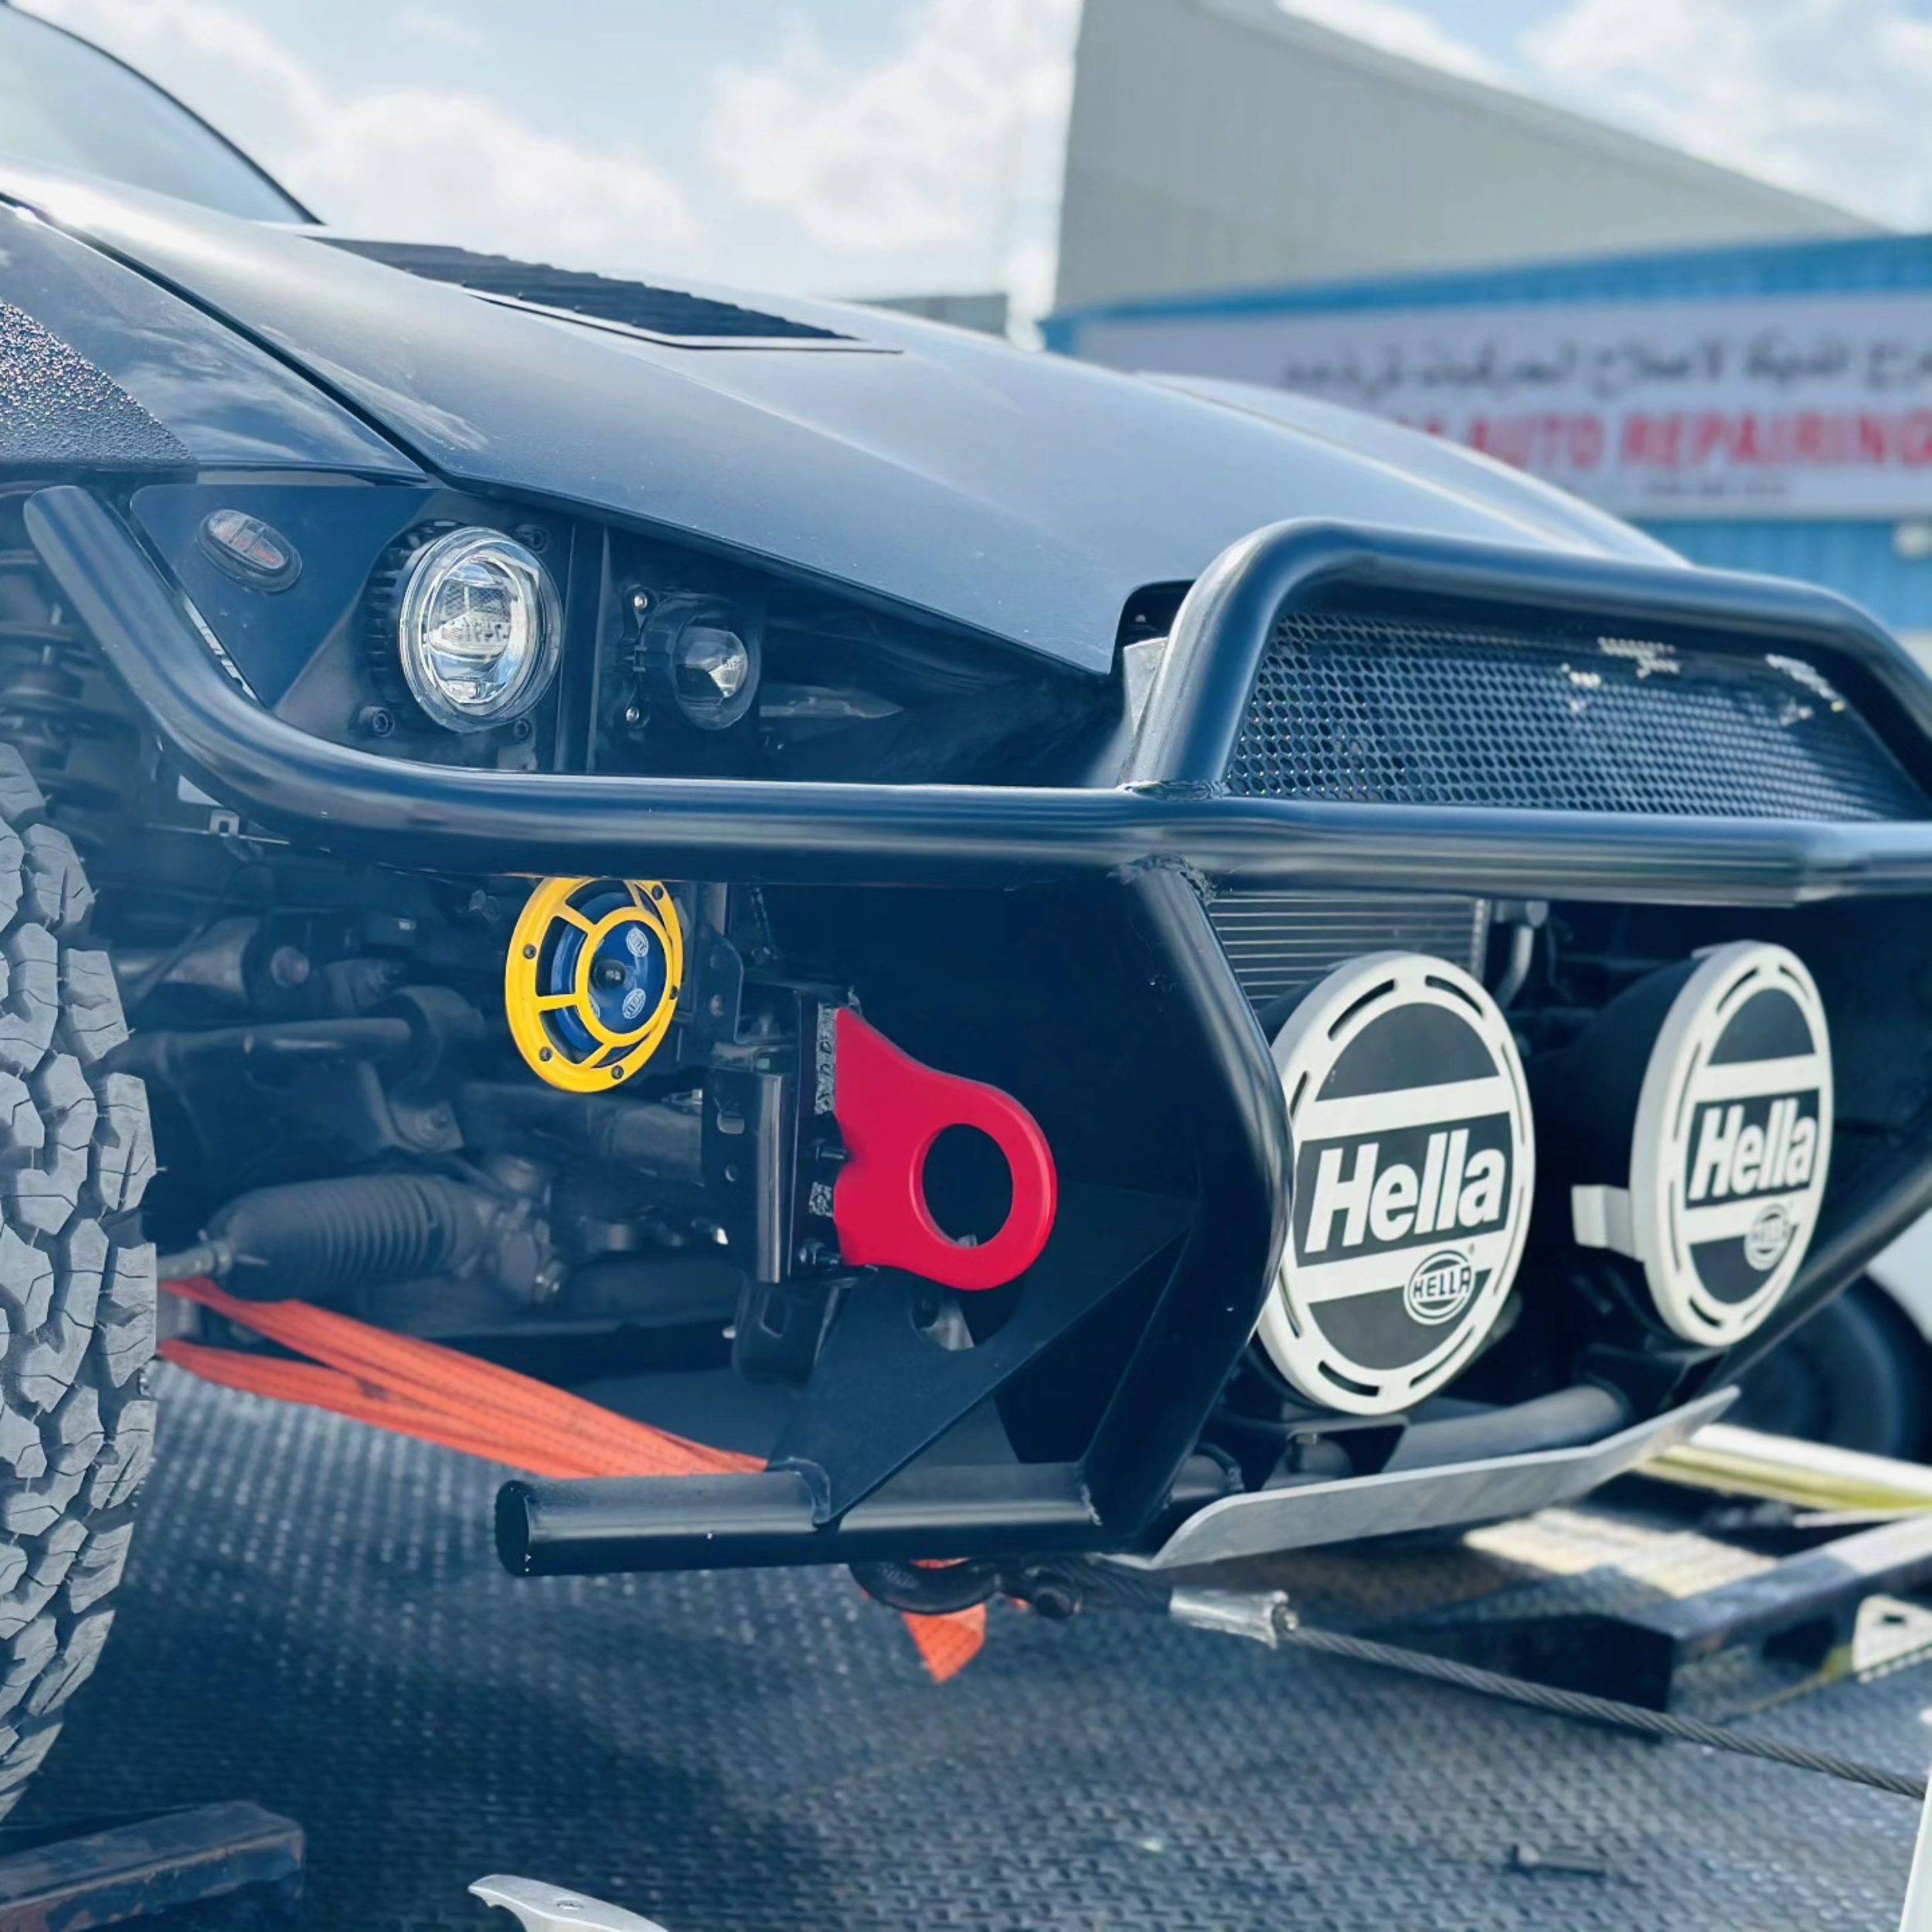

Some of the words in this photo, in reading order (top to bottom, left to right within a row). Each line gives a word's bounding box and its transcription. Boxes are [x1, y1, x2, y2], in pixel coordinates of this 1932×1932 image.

[1626, 406, 1932, 470] REPAIRING
[1304, 1129, 1506, 1253] Hella
[1689, 1098, 1817, 1201] Hella
[1413, 1265, 1471, 1300] HELLA
